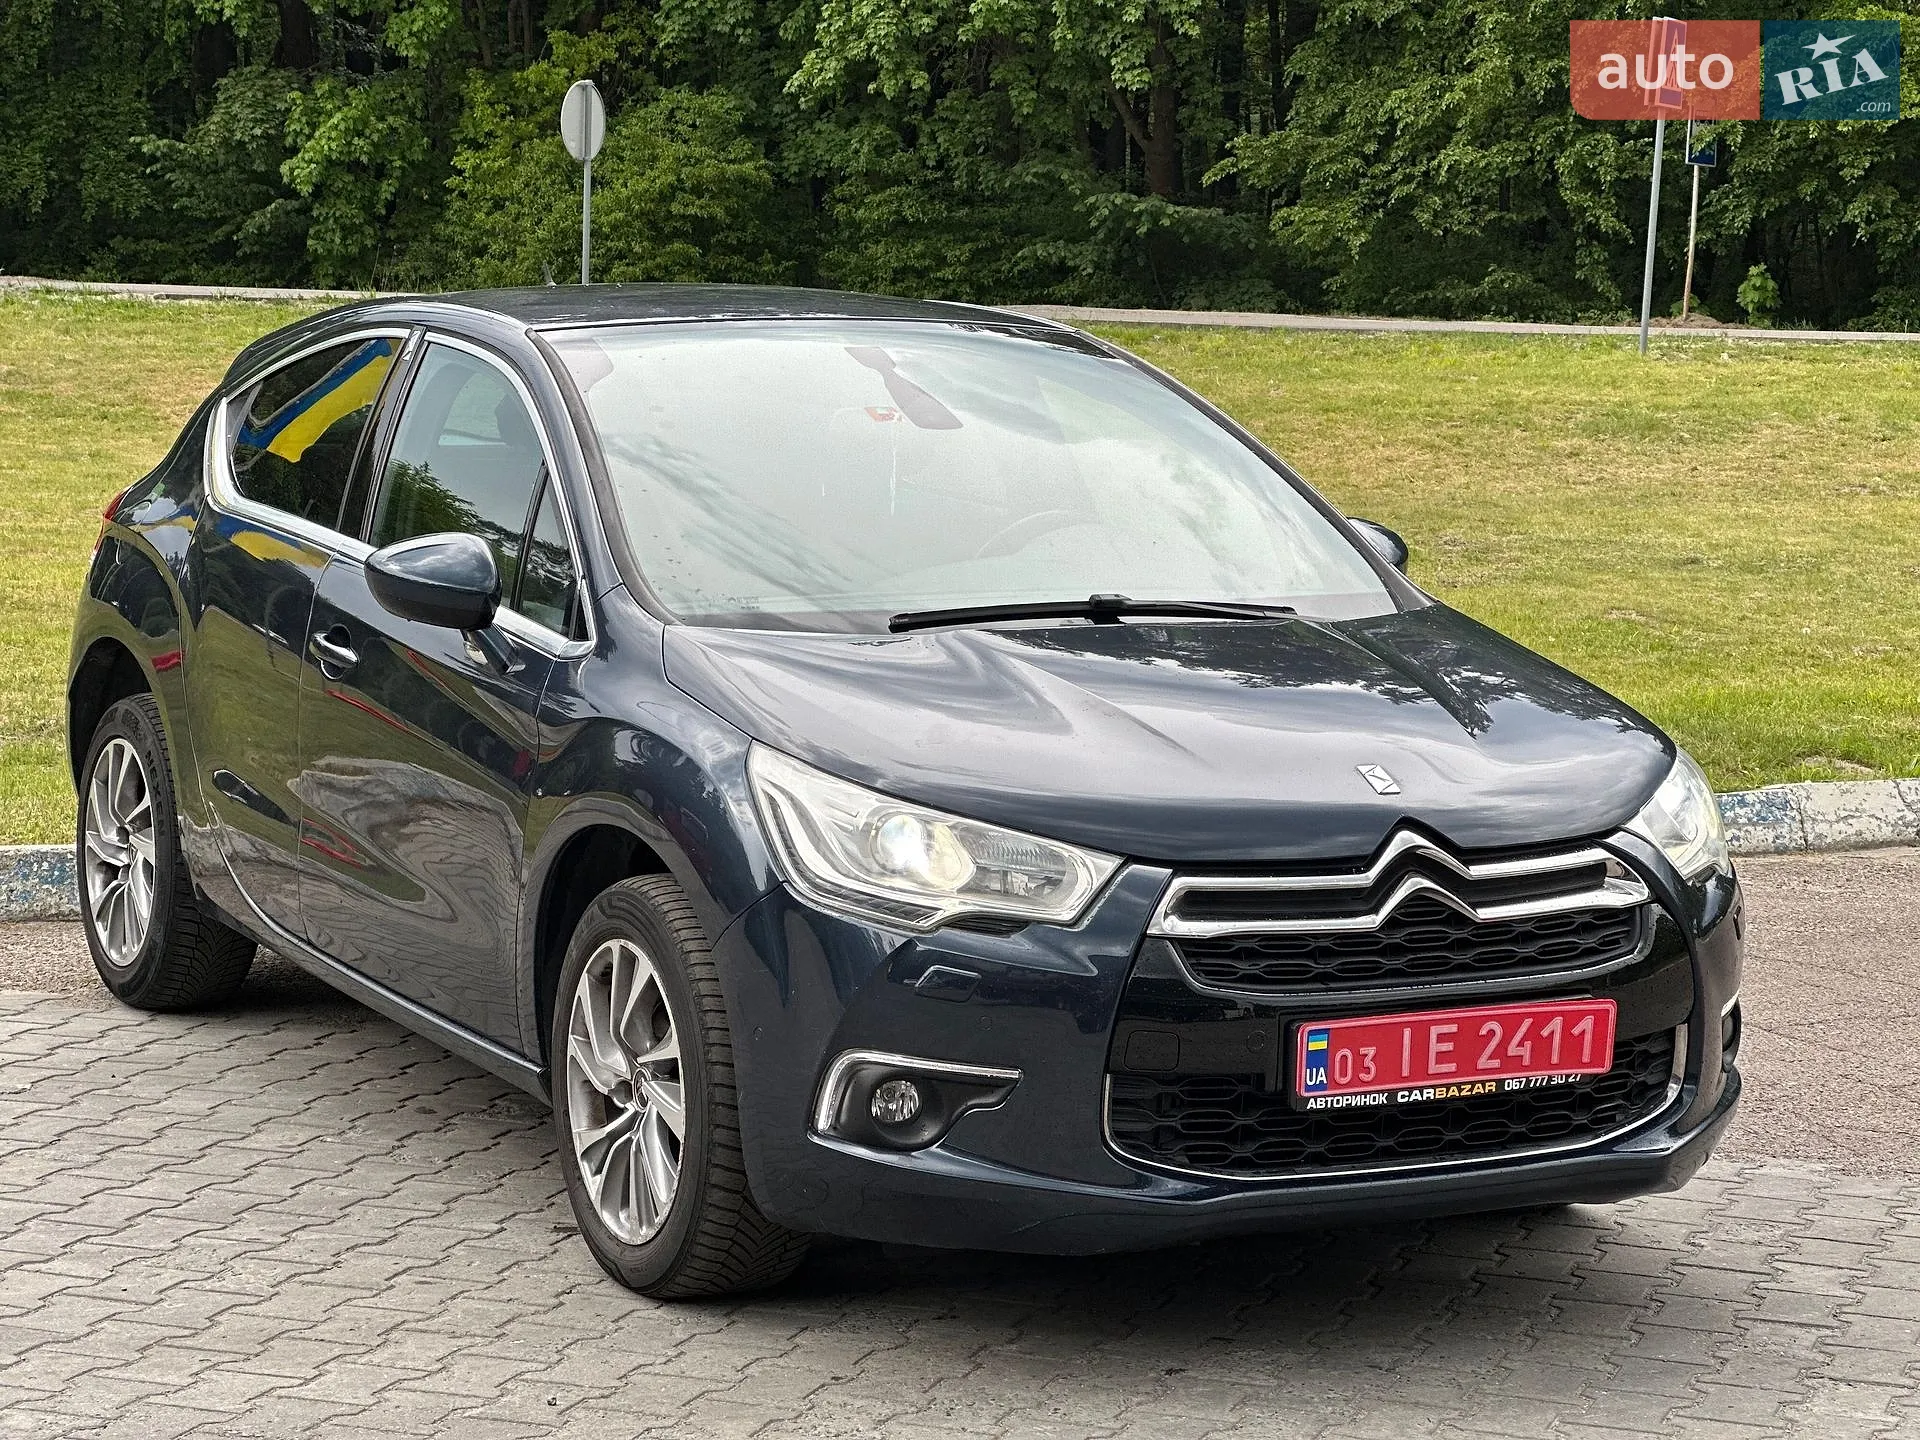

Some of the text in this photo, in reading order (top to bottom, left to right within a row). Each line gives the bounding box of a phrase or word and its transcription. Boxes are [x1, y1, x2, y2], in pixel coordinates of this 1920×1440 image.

[145, 749, 166, 837] NEXEN
[1306, 1067, 1328, 1086] UA
[1334, 1015, 1595, 1086] 03 IE 2411
[1306, 1092, 1389, 1110] АВТОРИНОК
[1397, 1081, 1497, 1103] CARBAZAR
[1504, 1077, 1527, 1091] 067
[1528, 1075, 1549, 1088] 777
